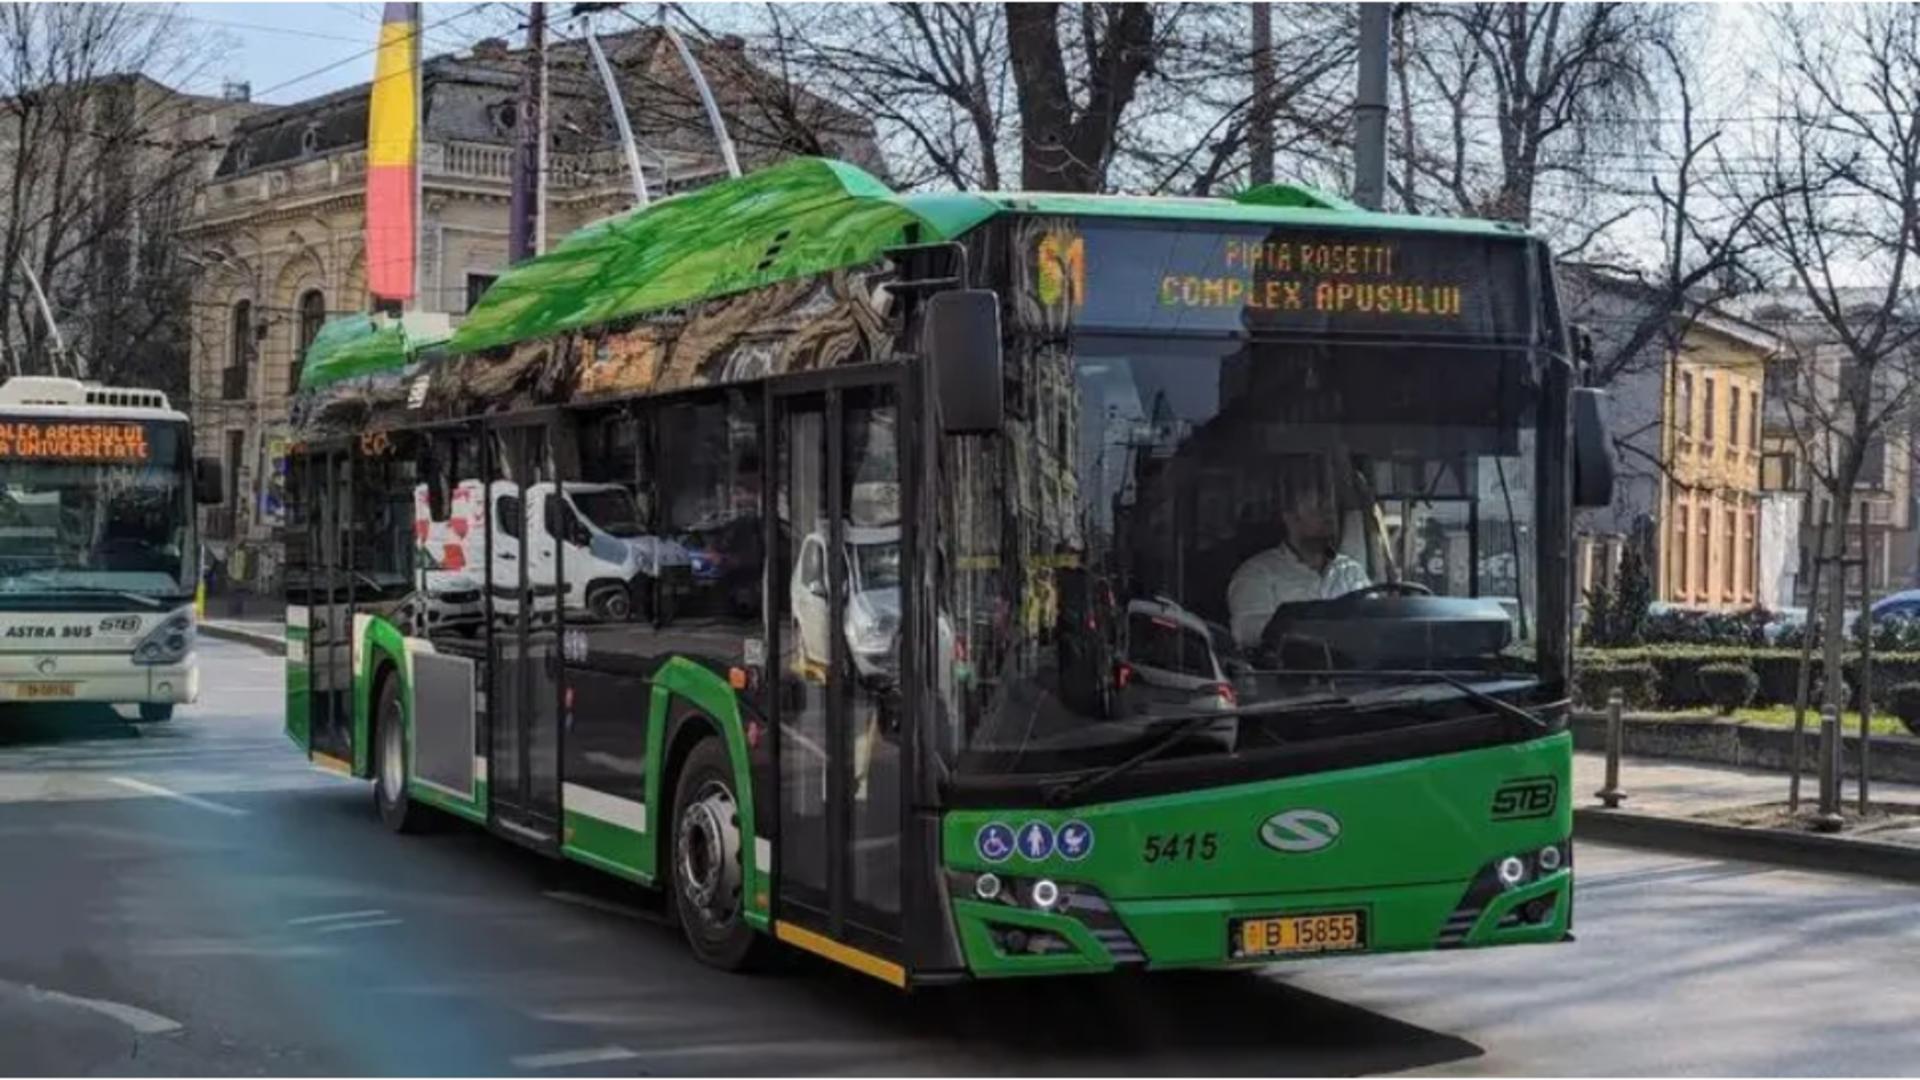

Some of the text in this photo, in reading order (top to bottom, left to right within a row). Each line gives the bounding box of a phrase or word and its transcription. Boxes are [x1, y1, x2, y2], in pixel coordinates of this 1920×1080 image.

[1159, 275, 1461, 315] COMPLEX APUSULUI
[5, 625, 92, 638] ASTRA BUS
[1492, 781, 1555, 817] STB
[1142, 832, 1219, 864] 5415
[1265, 916, 1355, 946] B 15855
